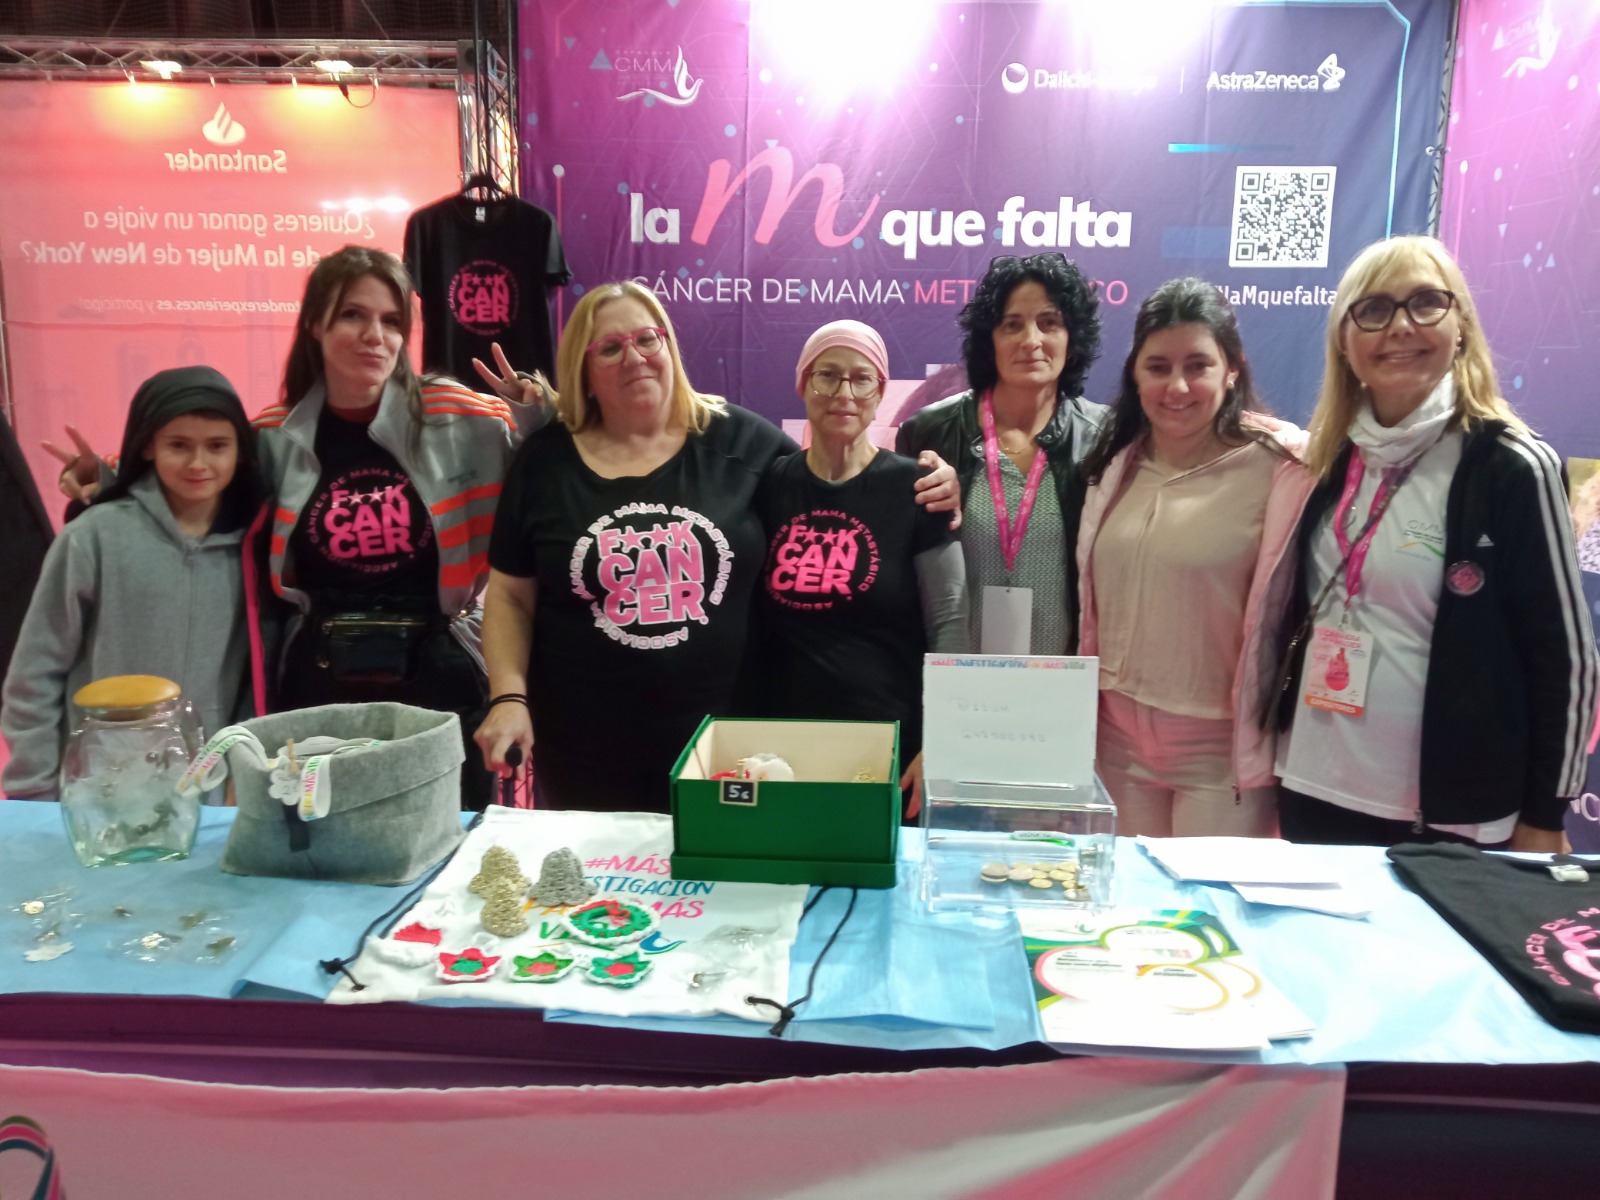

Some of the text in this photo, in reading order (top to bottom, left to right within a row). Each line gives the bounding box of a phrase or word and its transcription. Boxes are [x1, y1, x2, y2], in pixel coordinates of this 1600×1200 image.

[615, 57, 672, 72] CMM
[1207, 70, 1319, 92] AstraZeneca
[630, 192, 680, 244] la
[881, 208, 986, 260] que
[997, 196, 1132, 247] falta
[458, 286, 510, 305] CAN
[762, 277, 802, 303] DE
[810, 279, 906, 304] MAMA
[460, 303, 510, 323] CER
[328, 476, 347, 491] DE
[324, 502, 412, 536] CAN
[587, 515, 615, 535] DE
[613, 502, 669, 518] MAMA
[790, 513, 807, 524] DE
[811, 509, 847, 520] MAMA
[328, 527, 415, 559] CER
[597, 543, 705, 592] CAN
[777, 543, 859, 571] CAN
[771, 565, 852, 595] CER
[604, 582, 706, 626] CER
[584, 854, 672, 876] #MÁS
